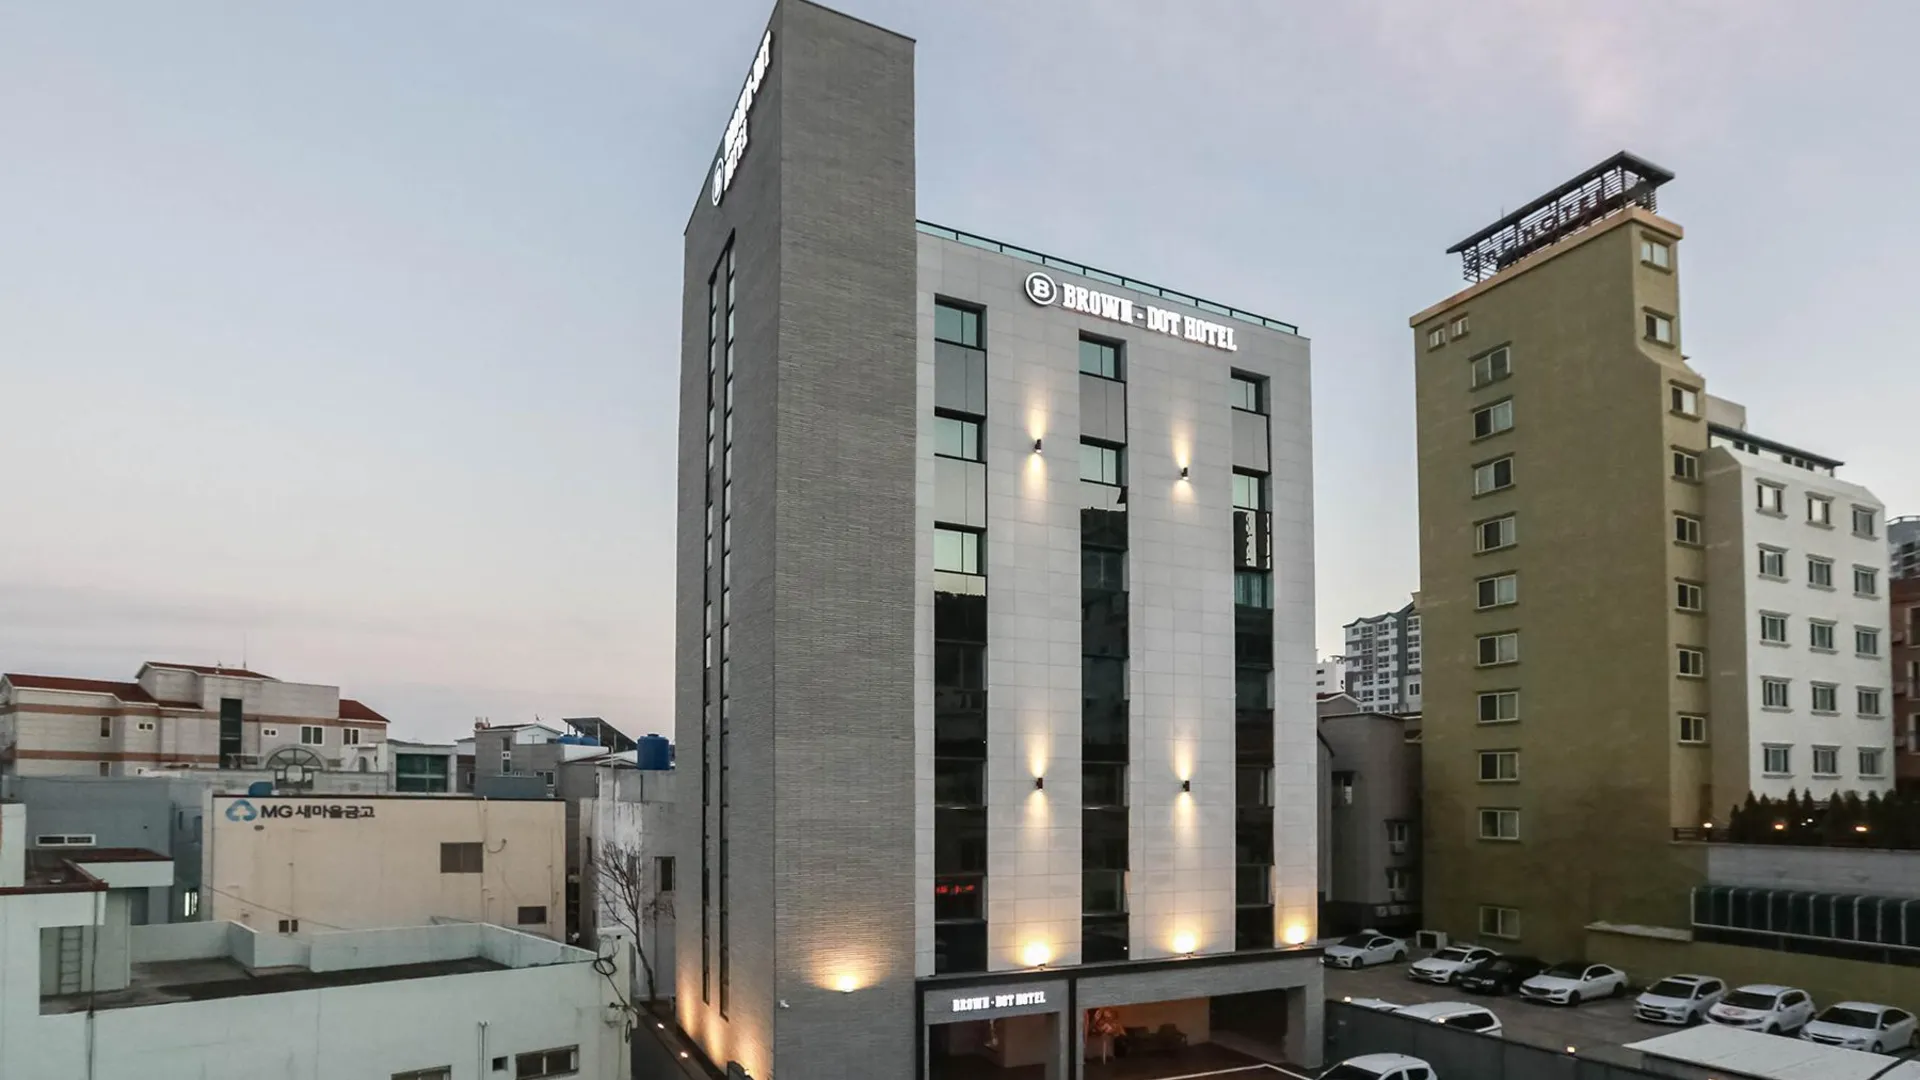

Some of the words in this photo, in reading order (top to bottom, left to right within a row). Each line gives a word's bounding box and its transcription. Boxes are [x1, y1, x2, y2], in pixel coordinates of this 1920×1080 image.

[1062, 282, 1134, 324] BROWN
[1147, 305, 1181, 336] DOT
[1183, 315, 1238, 351] HOTEL
[261, 805, 293, 818] MG
[295, 805, 375, 819] 새마을금고
[1015, 991, 1046, 1006] HOTEL
